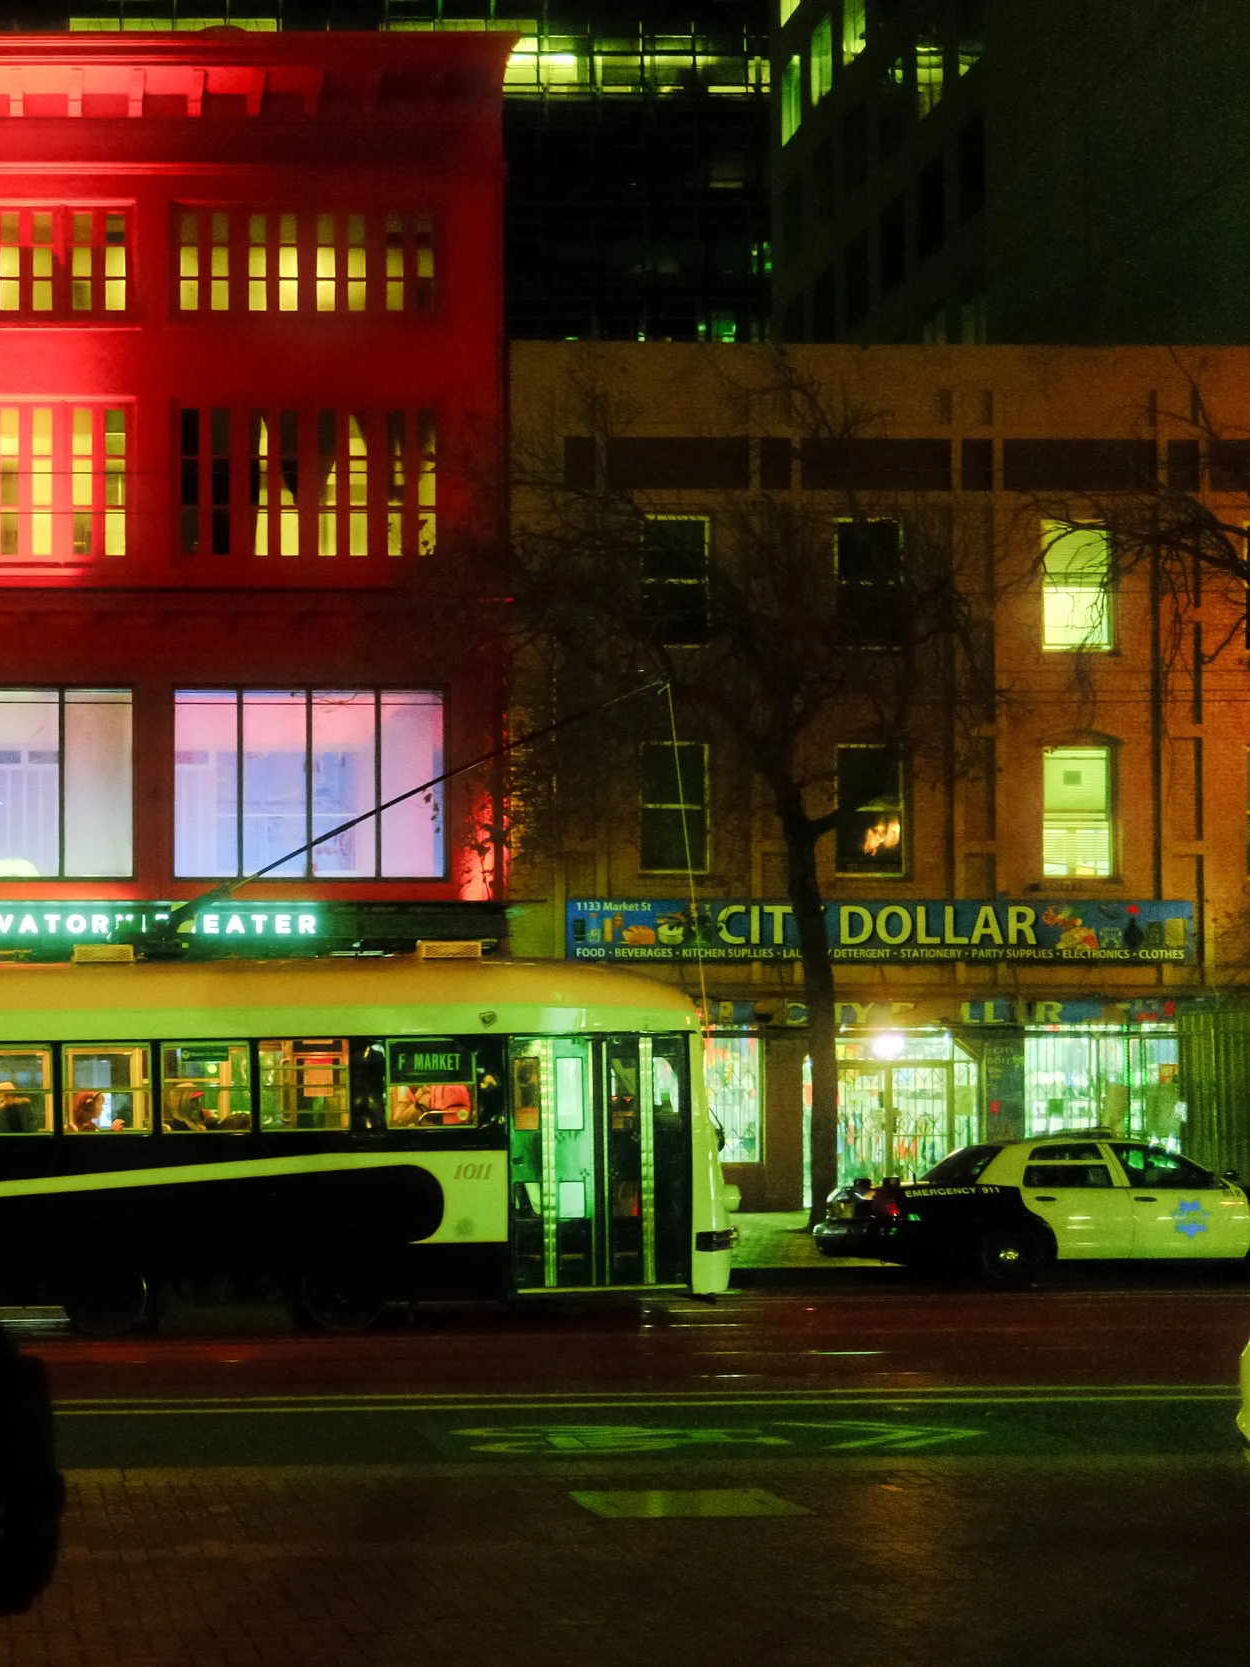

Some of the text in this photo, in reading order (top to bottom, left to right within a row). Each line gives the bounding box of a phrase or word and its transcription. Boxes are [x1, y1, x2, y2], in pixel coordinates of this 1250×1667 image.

[576, 902, 652, 911] 1133 Market St
[154, 913, 317, 934] EATER
[717, 905, 1037, 945] CIT DOLLAR
[576, 949, 606, 959] FOOD
[615, 949, 673, 959] BEVERAGES
[681, 949, 726, 959] KITCHEN
[834, 949, 891, 959] DETERGENT
[900, 949, 963, 959] STATIONERY
[971, 949, 1004, 959] PARTY
[1006, 949, 1054, 959] SUPPLIES
[1062, 949, 1130, 959] ELECTRONICS
[1139, 949, 1185, 959] CLOTHES
[398, 1053, 461, 1071] F MARKET
[453, 1163, 493, 1180] 1011
[904, 1186, 1000, 1198] EMERGENCY 911
